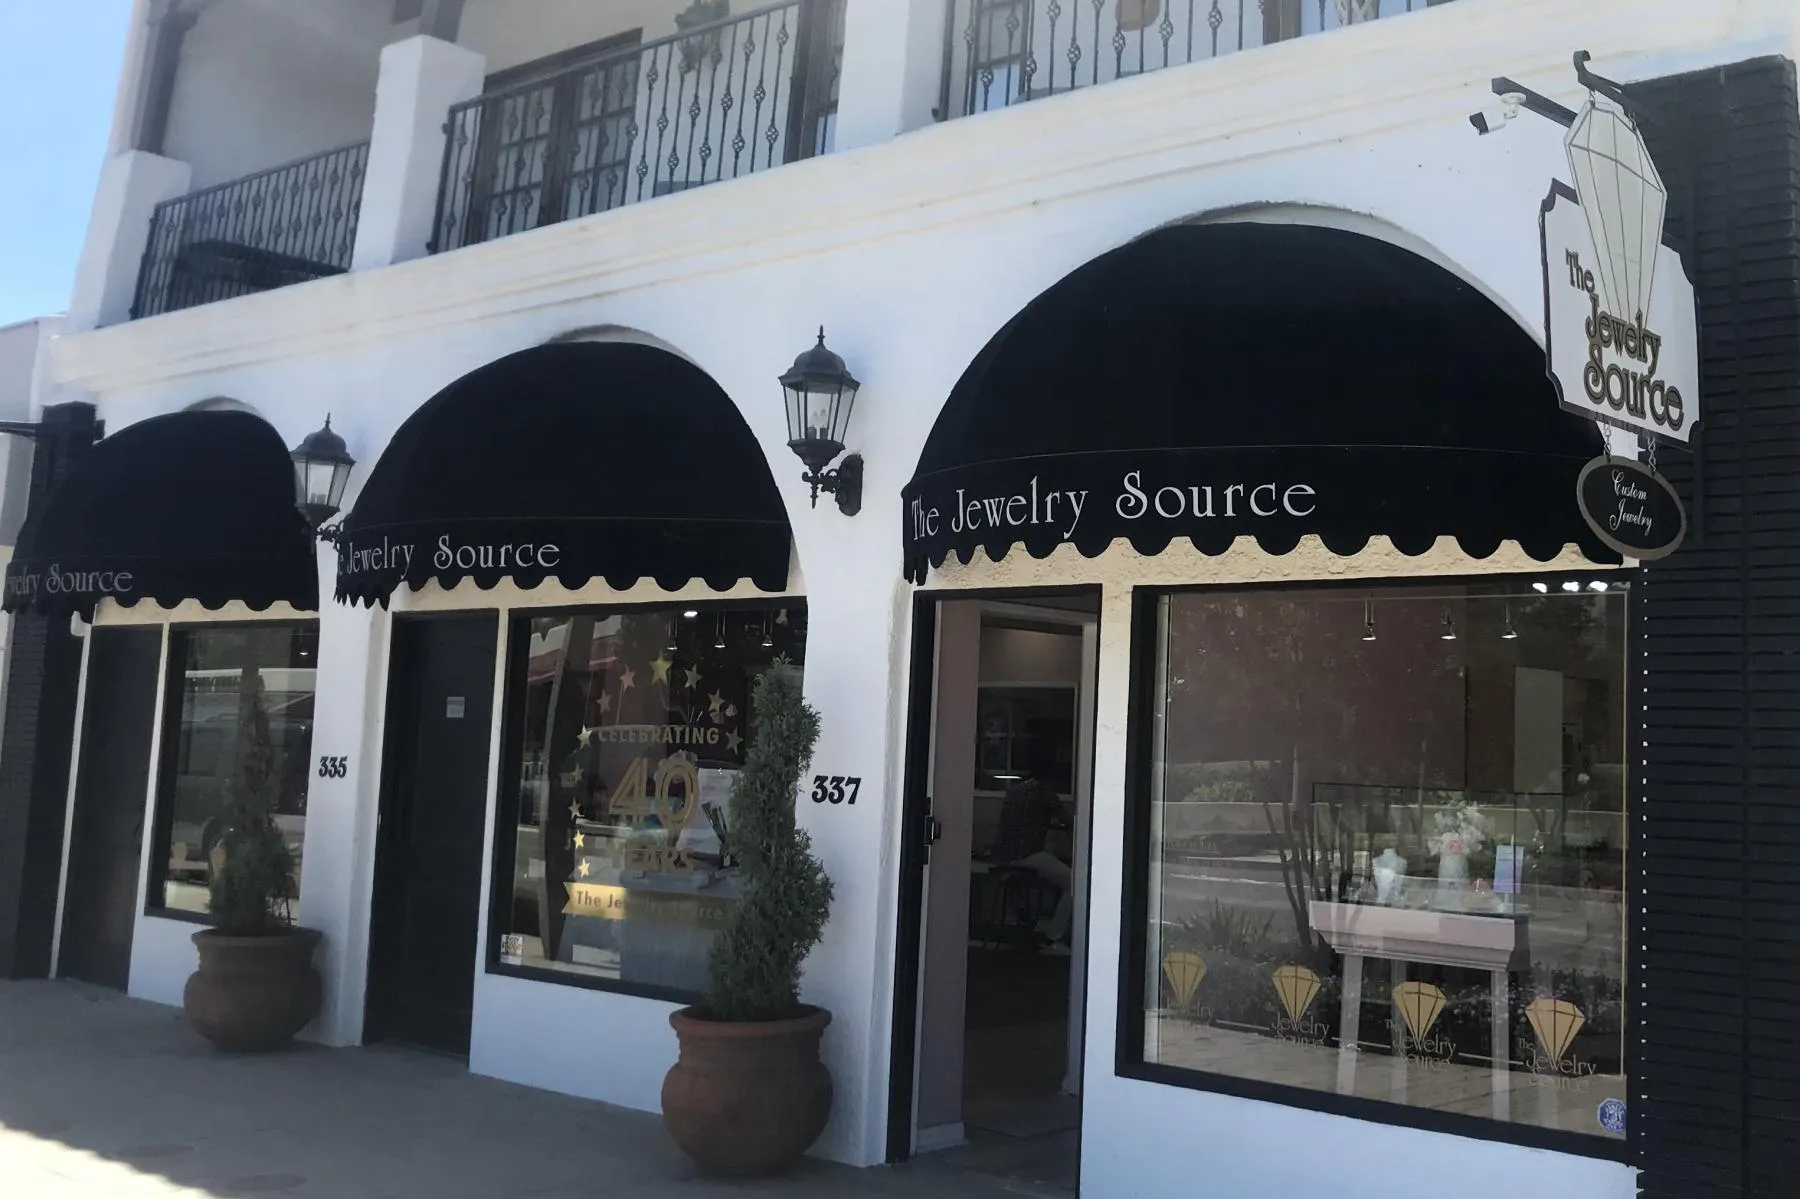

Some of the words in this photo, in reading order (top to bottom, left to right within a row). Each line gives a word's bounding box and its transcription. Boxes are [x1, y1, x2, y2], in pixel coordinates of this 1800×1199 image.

[1565, 248, 1595, 293] The
[1585, 293, 1661, 378] Jewelry
[1583, 343, 1684, 431] Source
[1611, 469, 1648, 500] Custom
[911, 494, 940, 541] The
[951, 475, 1089, 539] Jewelry
[1115, 470, 1317, 519] Source
[1609, 498, 1652, 537] Jewelry
[347, 536, 415, 580] Jewelry
[433, 534, 561, 570] Source
[46, 563, 133, 594] Source
[597, 726, 720, 745] CELEBRATING
[318, 755, 348, 778] 335
[608, 756, 700, 830] 40
[811, 775, 862, 805] 337
[608, 844, 694, 875] EARS
[576, 890, 601, 907] The
[1270, 1011, 1330, 1041] Jewelry
[1526, 1048, 1597, 1083] Jewelry
